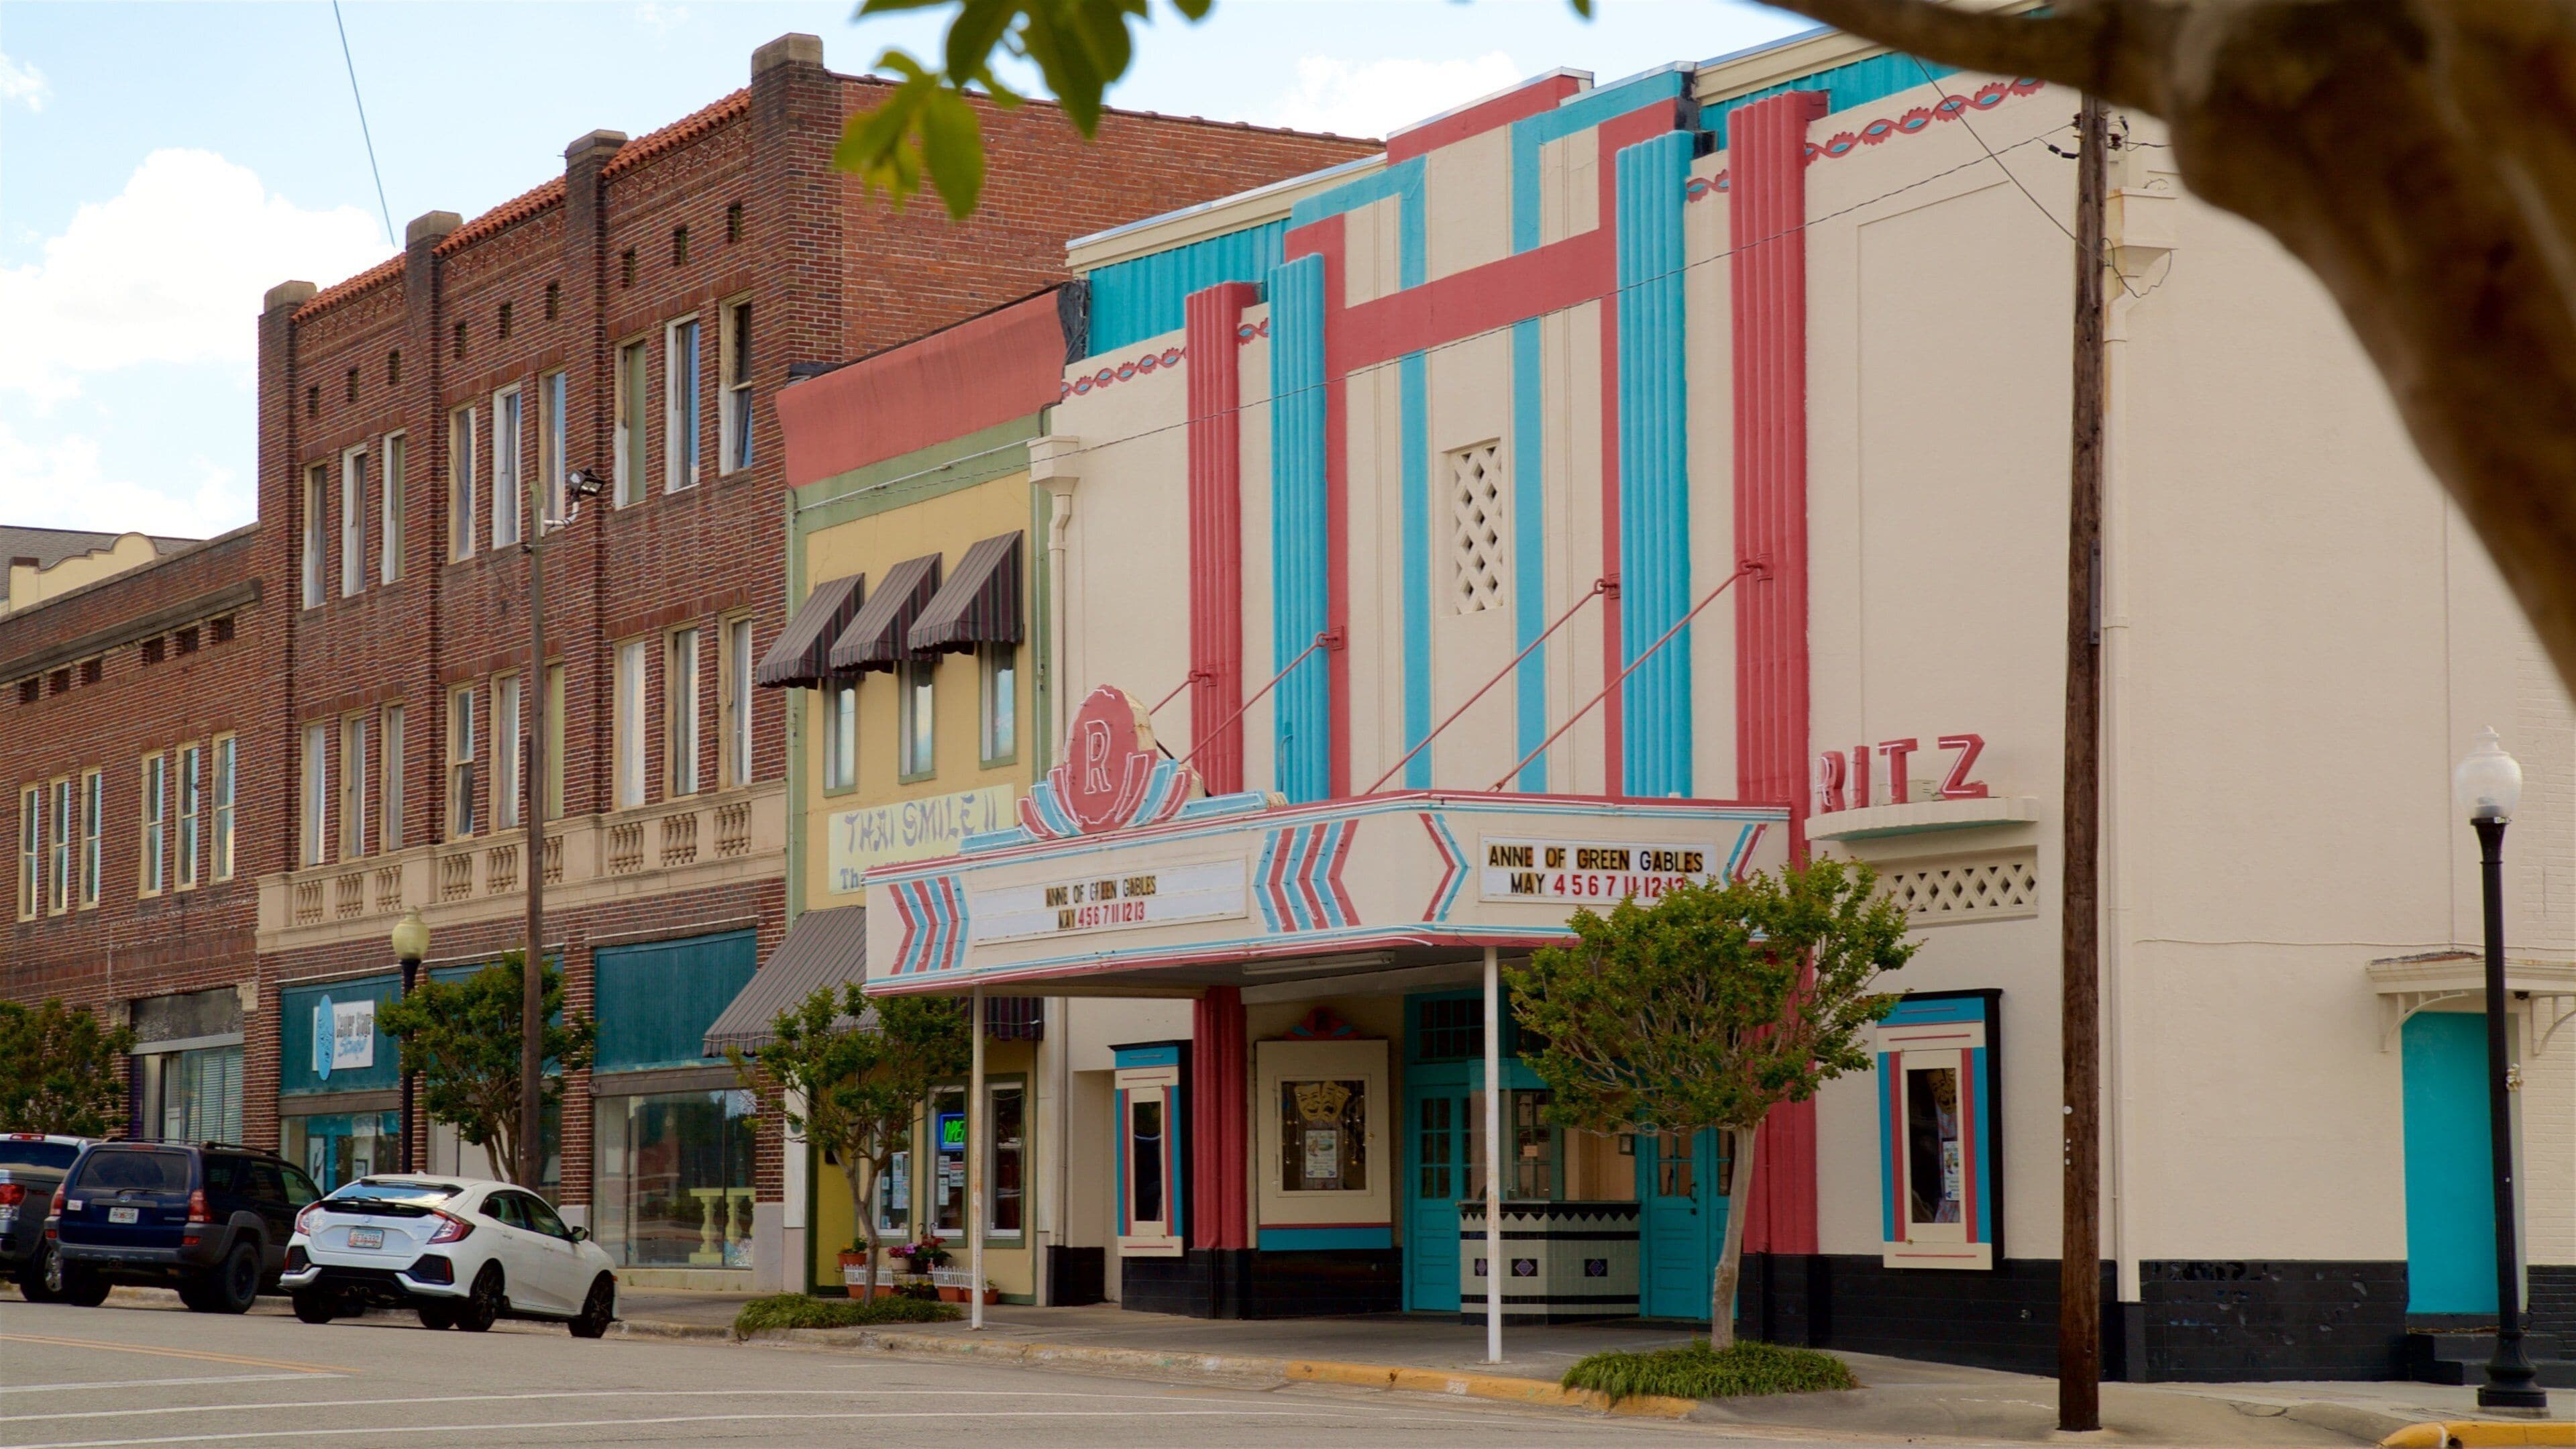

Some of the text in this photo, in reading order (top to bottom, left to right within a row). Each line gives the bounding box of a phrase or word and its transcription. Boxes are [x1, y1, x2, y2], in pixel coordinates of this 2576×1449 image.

[1084, 718, 1112, 795] R
[1815, 734, 1988, 814] RITZ
[845, 807, 894, 854] THAI
[902, 792, 975, 847] SMILE
[1489, 845, 1703, 873] ANNE OF GREEN GABLES
[1046, 875, 1156, 907] ANNE OF GREEN GABLES
[1511, 873, 1545, 894] MAY
[1554, 874, 1565, 895] 4
[1572, 874, 1582, 896] 5
[1588, 875, 1599, 896] 6
[1606, 875, 1616, 896] 7
[1059, 909, 1075, 929] MAY
